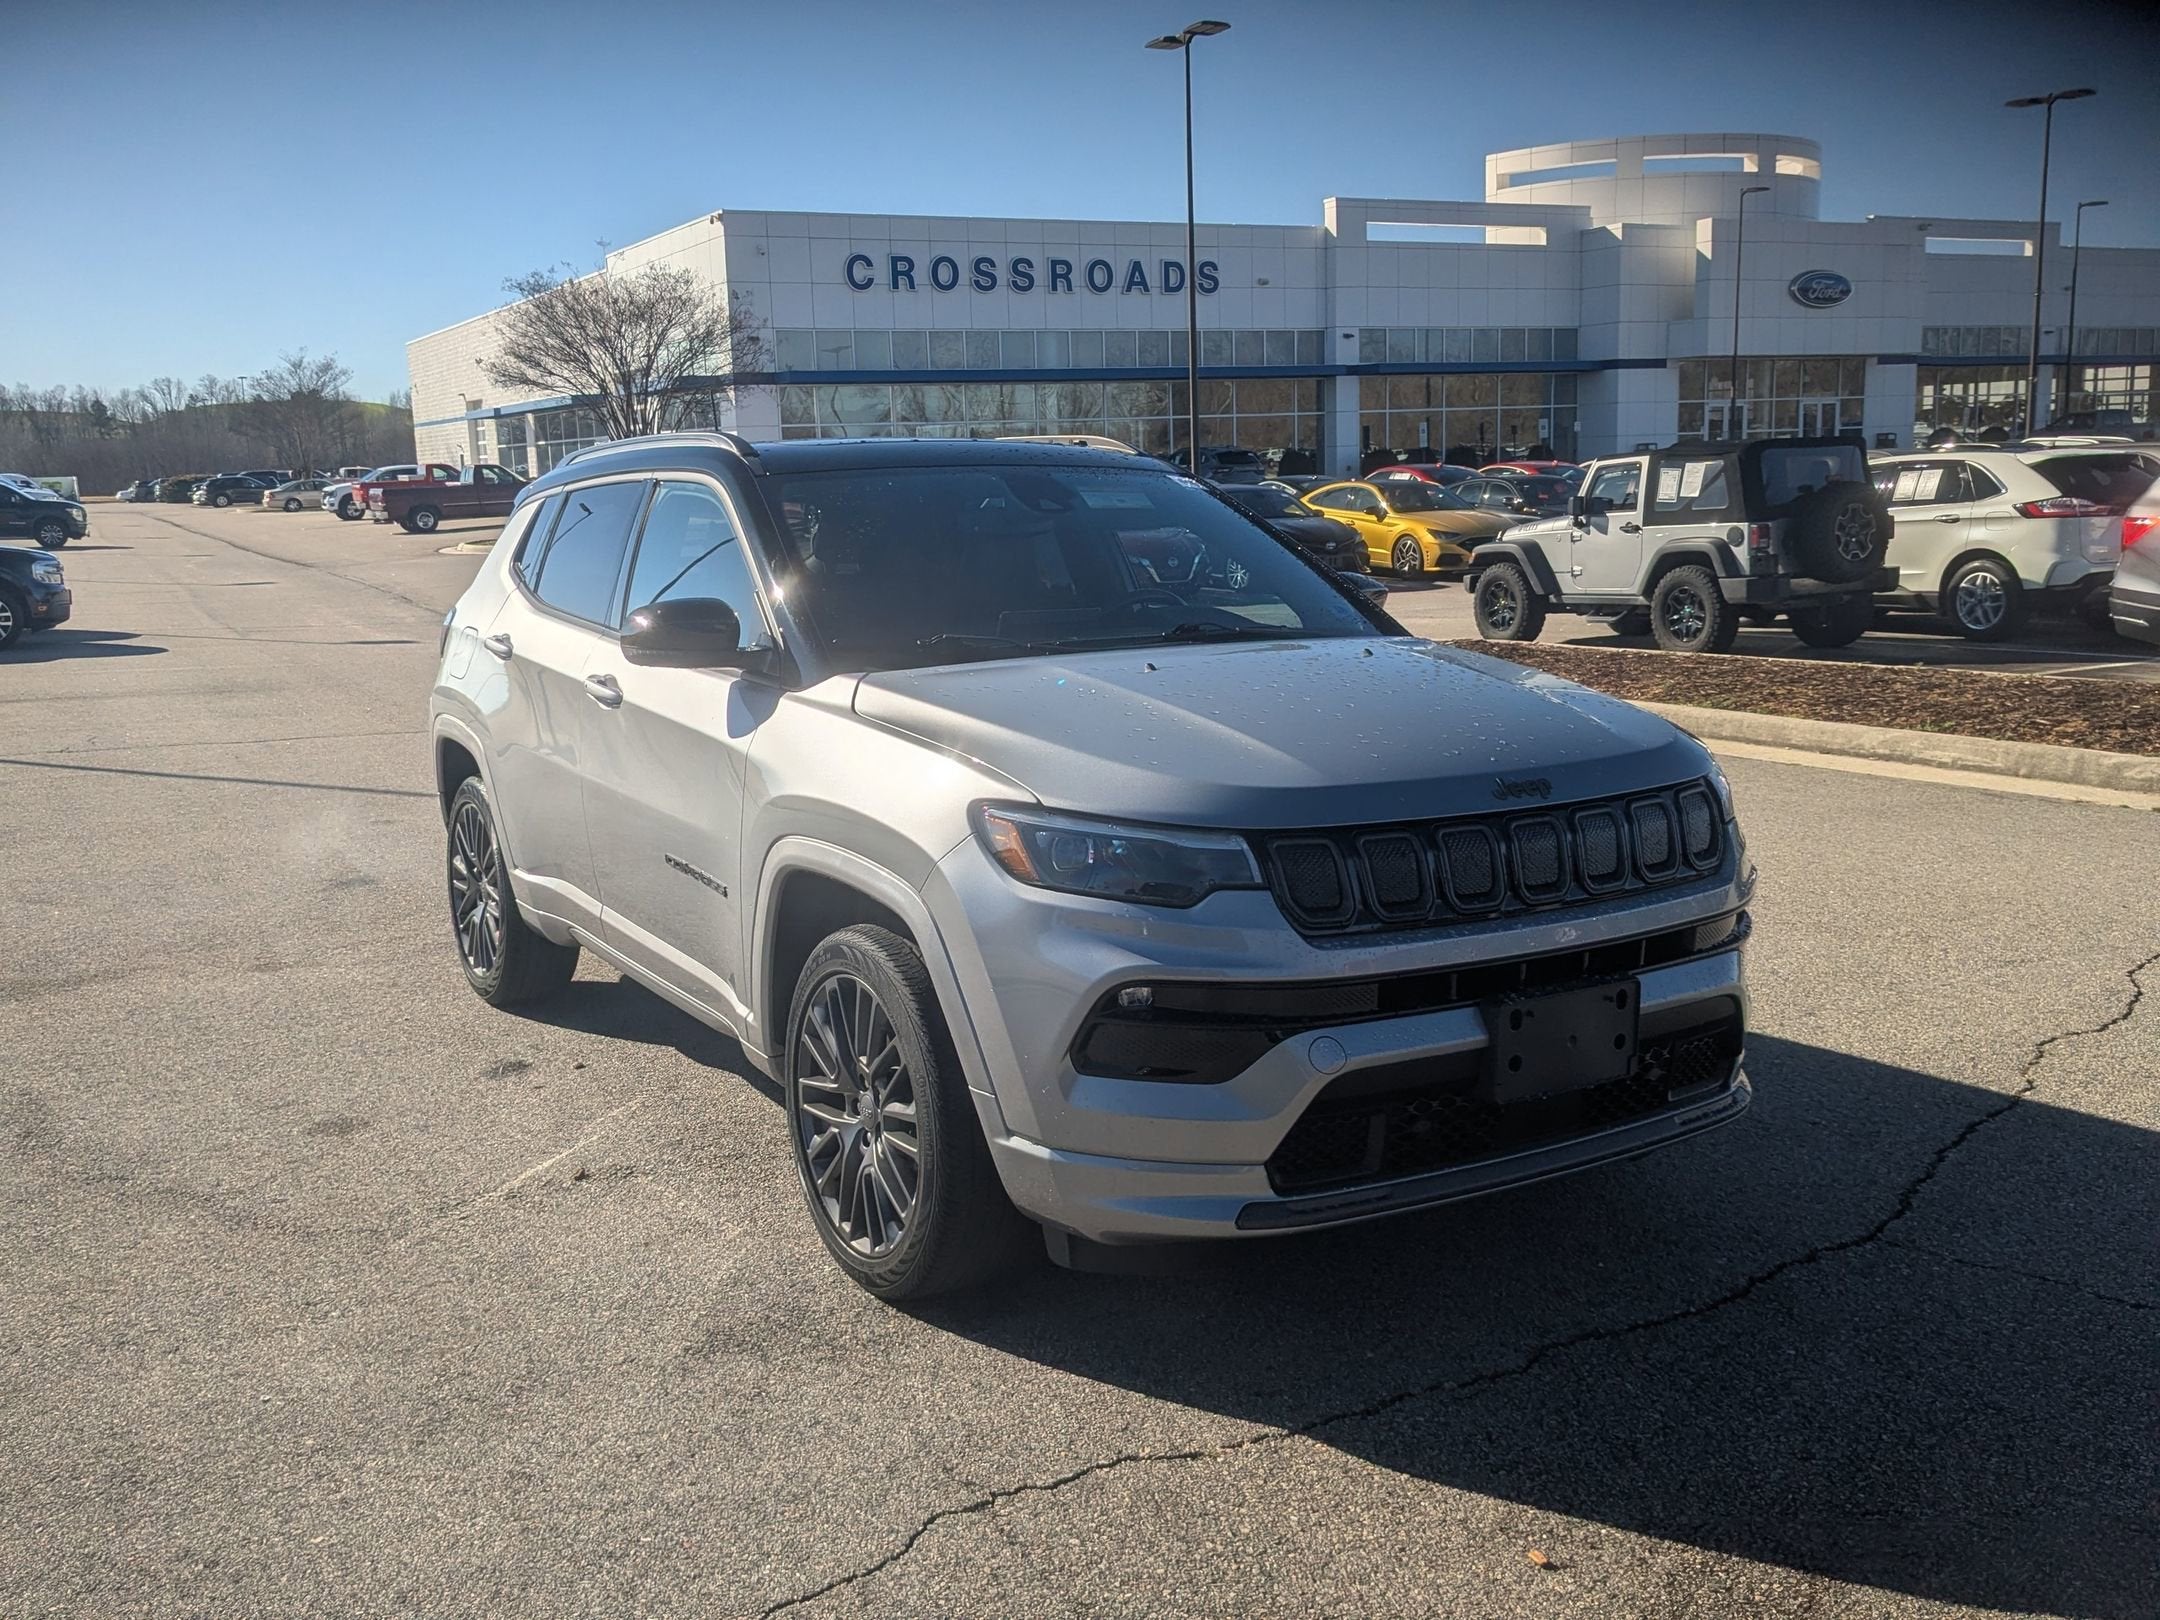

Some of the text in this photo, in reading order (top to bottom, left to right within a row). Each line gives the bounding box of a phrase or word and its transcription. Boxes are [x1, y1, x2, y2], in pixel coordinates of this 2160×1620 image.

[845, 253, 1220, 295] CROSSROADS
[1808, 279, 1844, 299] Ford
[1491, 776, 1553, 801] Jeep
